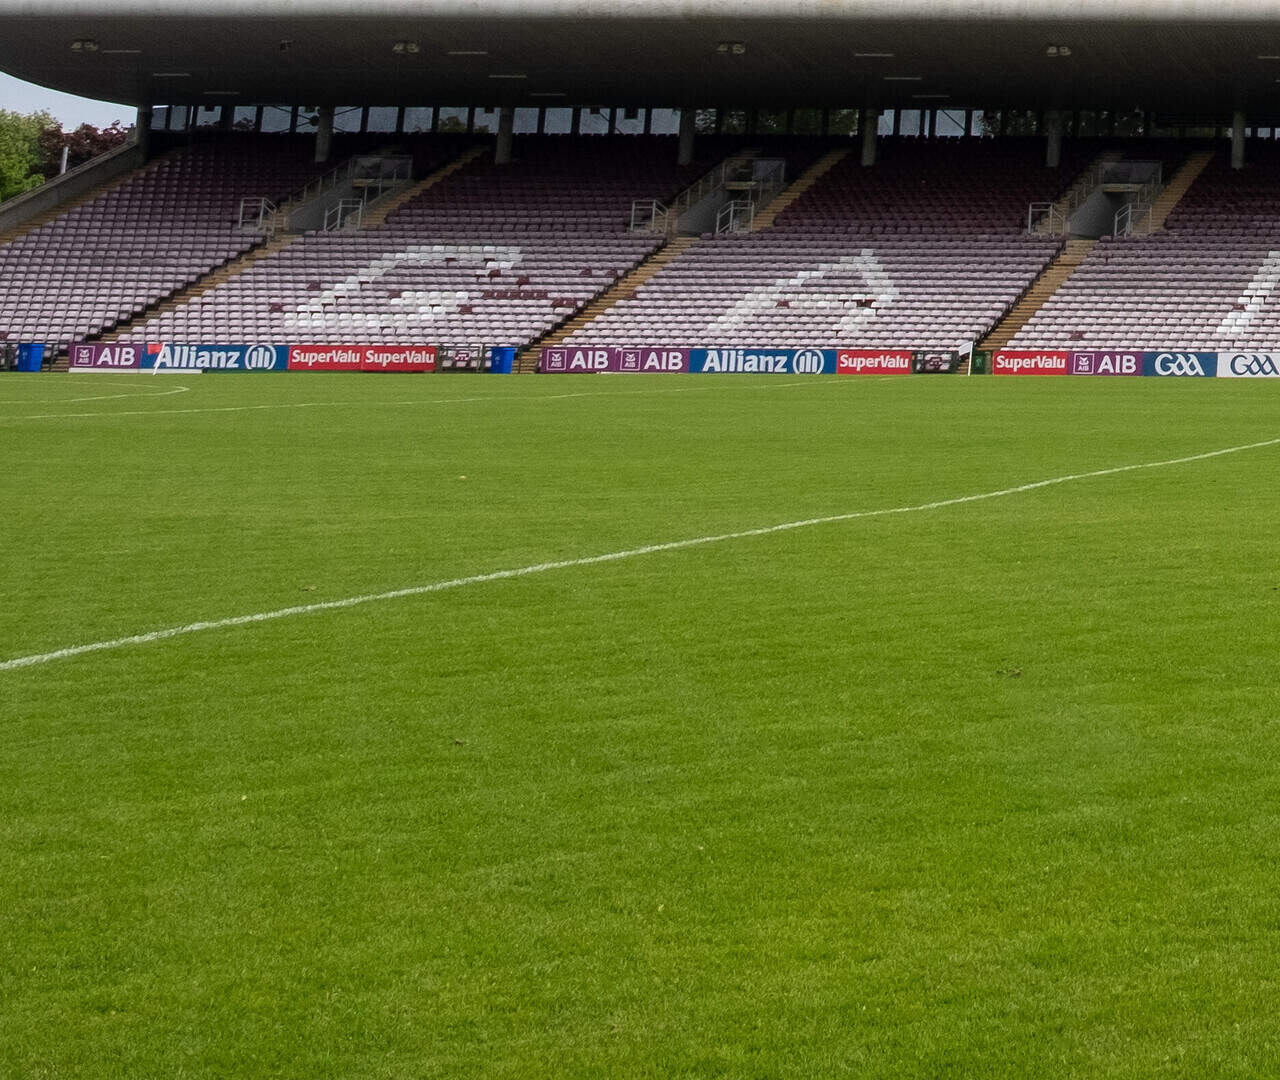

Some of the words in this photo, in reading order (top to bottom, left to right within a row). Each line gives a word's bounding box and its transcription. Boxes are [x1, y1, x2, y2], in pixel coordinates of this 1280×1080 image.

[97, 347, 135, 366] AIB
[156, 345, 240, 368] Allianz
[291, 350, 360, 367] SuperValu
[365, 350, 434, 367] SuperValu
[569, 350, 609, 369] AIB
[643, 351, 683, 370] AIB
[702, 350, 788, 373] Allianz
[839, 354, 909, 371] SuperValu
[996, 354, 1066, 372] SuperValu
[1097, 355, 1137, 373] AIB
[1154, 353, 1205, 376] GAA
[1230, 354, 1280, 376] GAA
